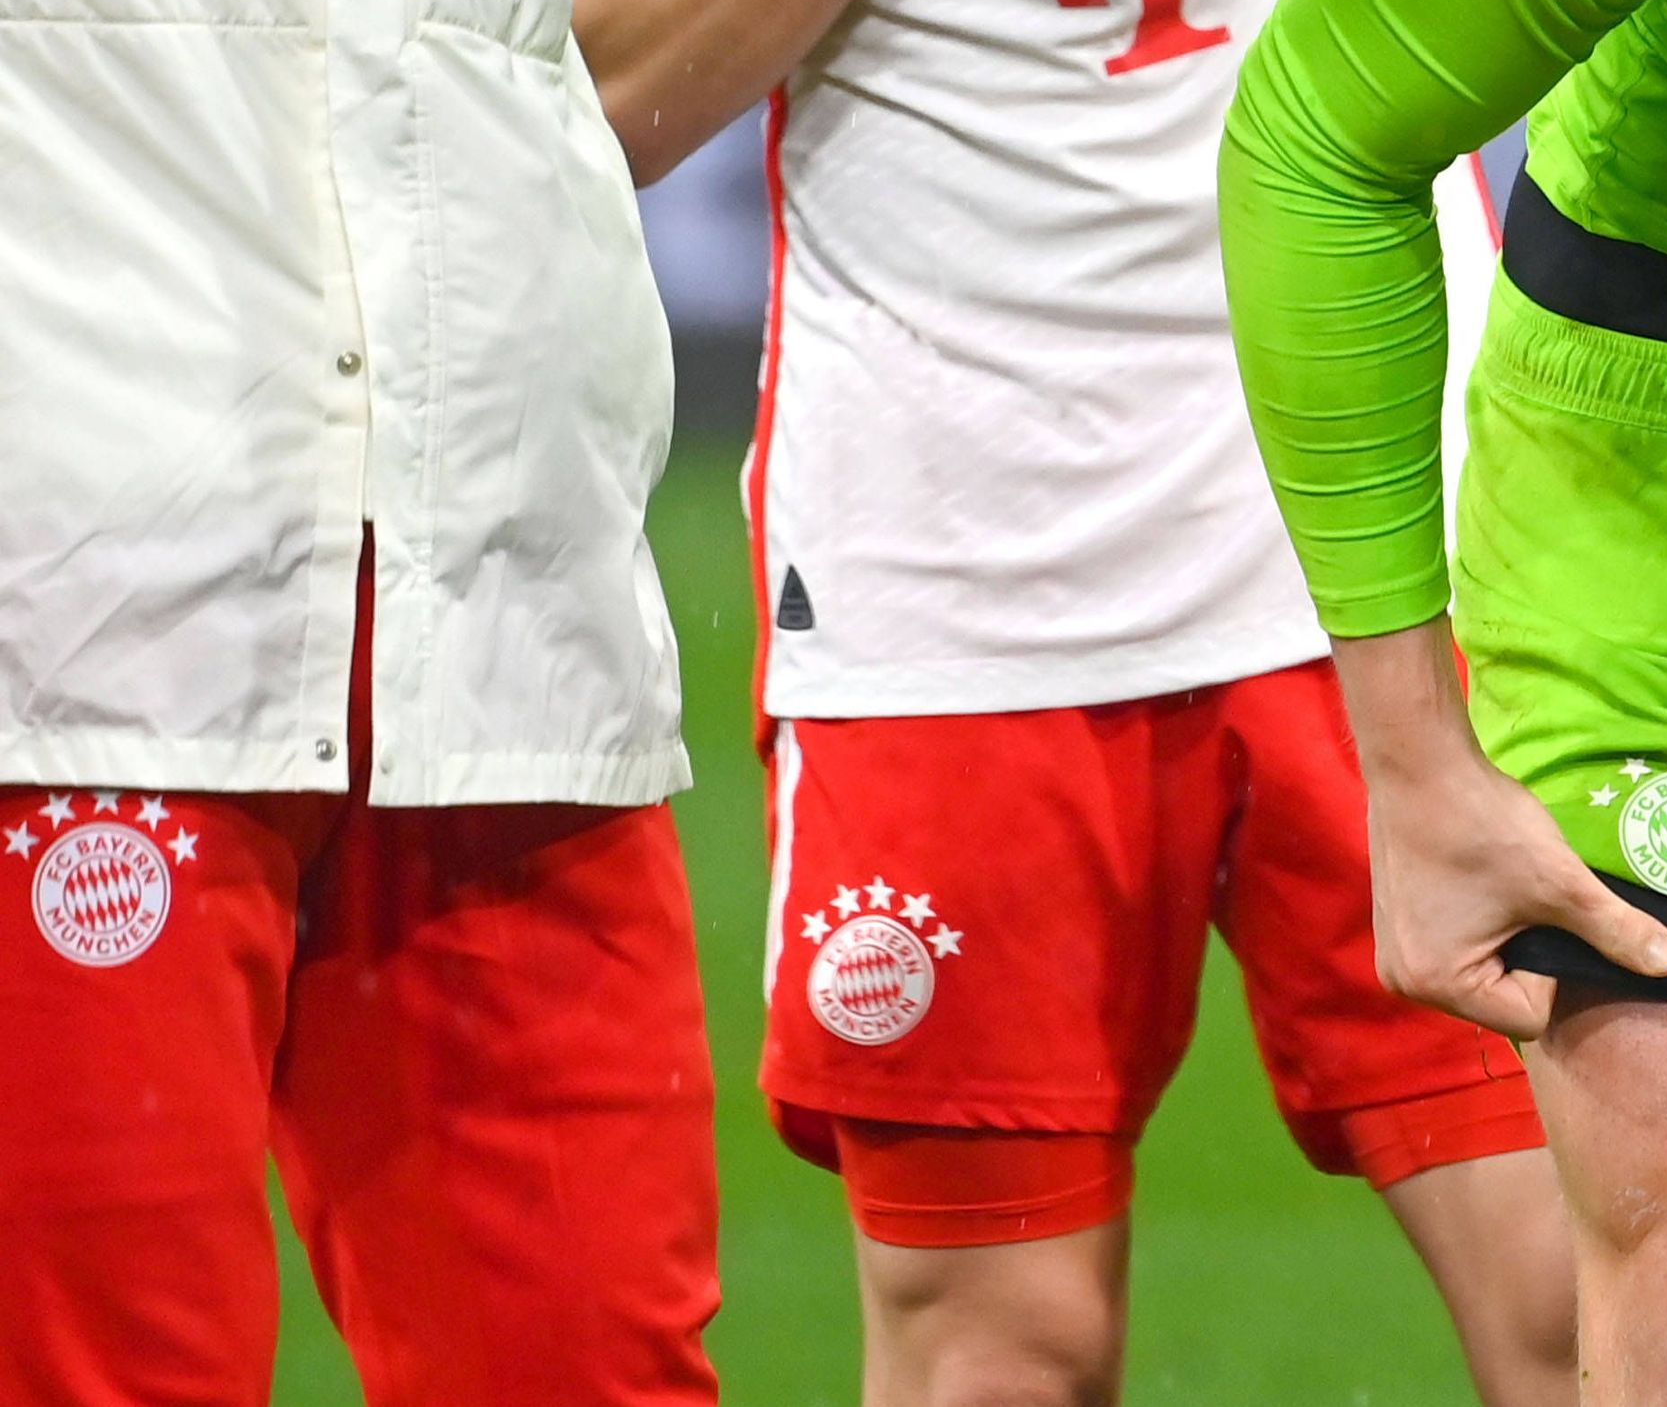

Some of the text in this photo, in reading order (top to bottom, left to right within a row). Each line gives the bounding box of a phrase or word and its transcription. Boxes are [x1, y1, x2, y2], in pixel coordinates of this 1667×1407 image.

[1631, 796, 1655, 822] FC
[47, 836, 159, 884] FC BAYERN
